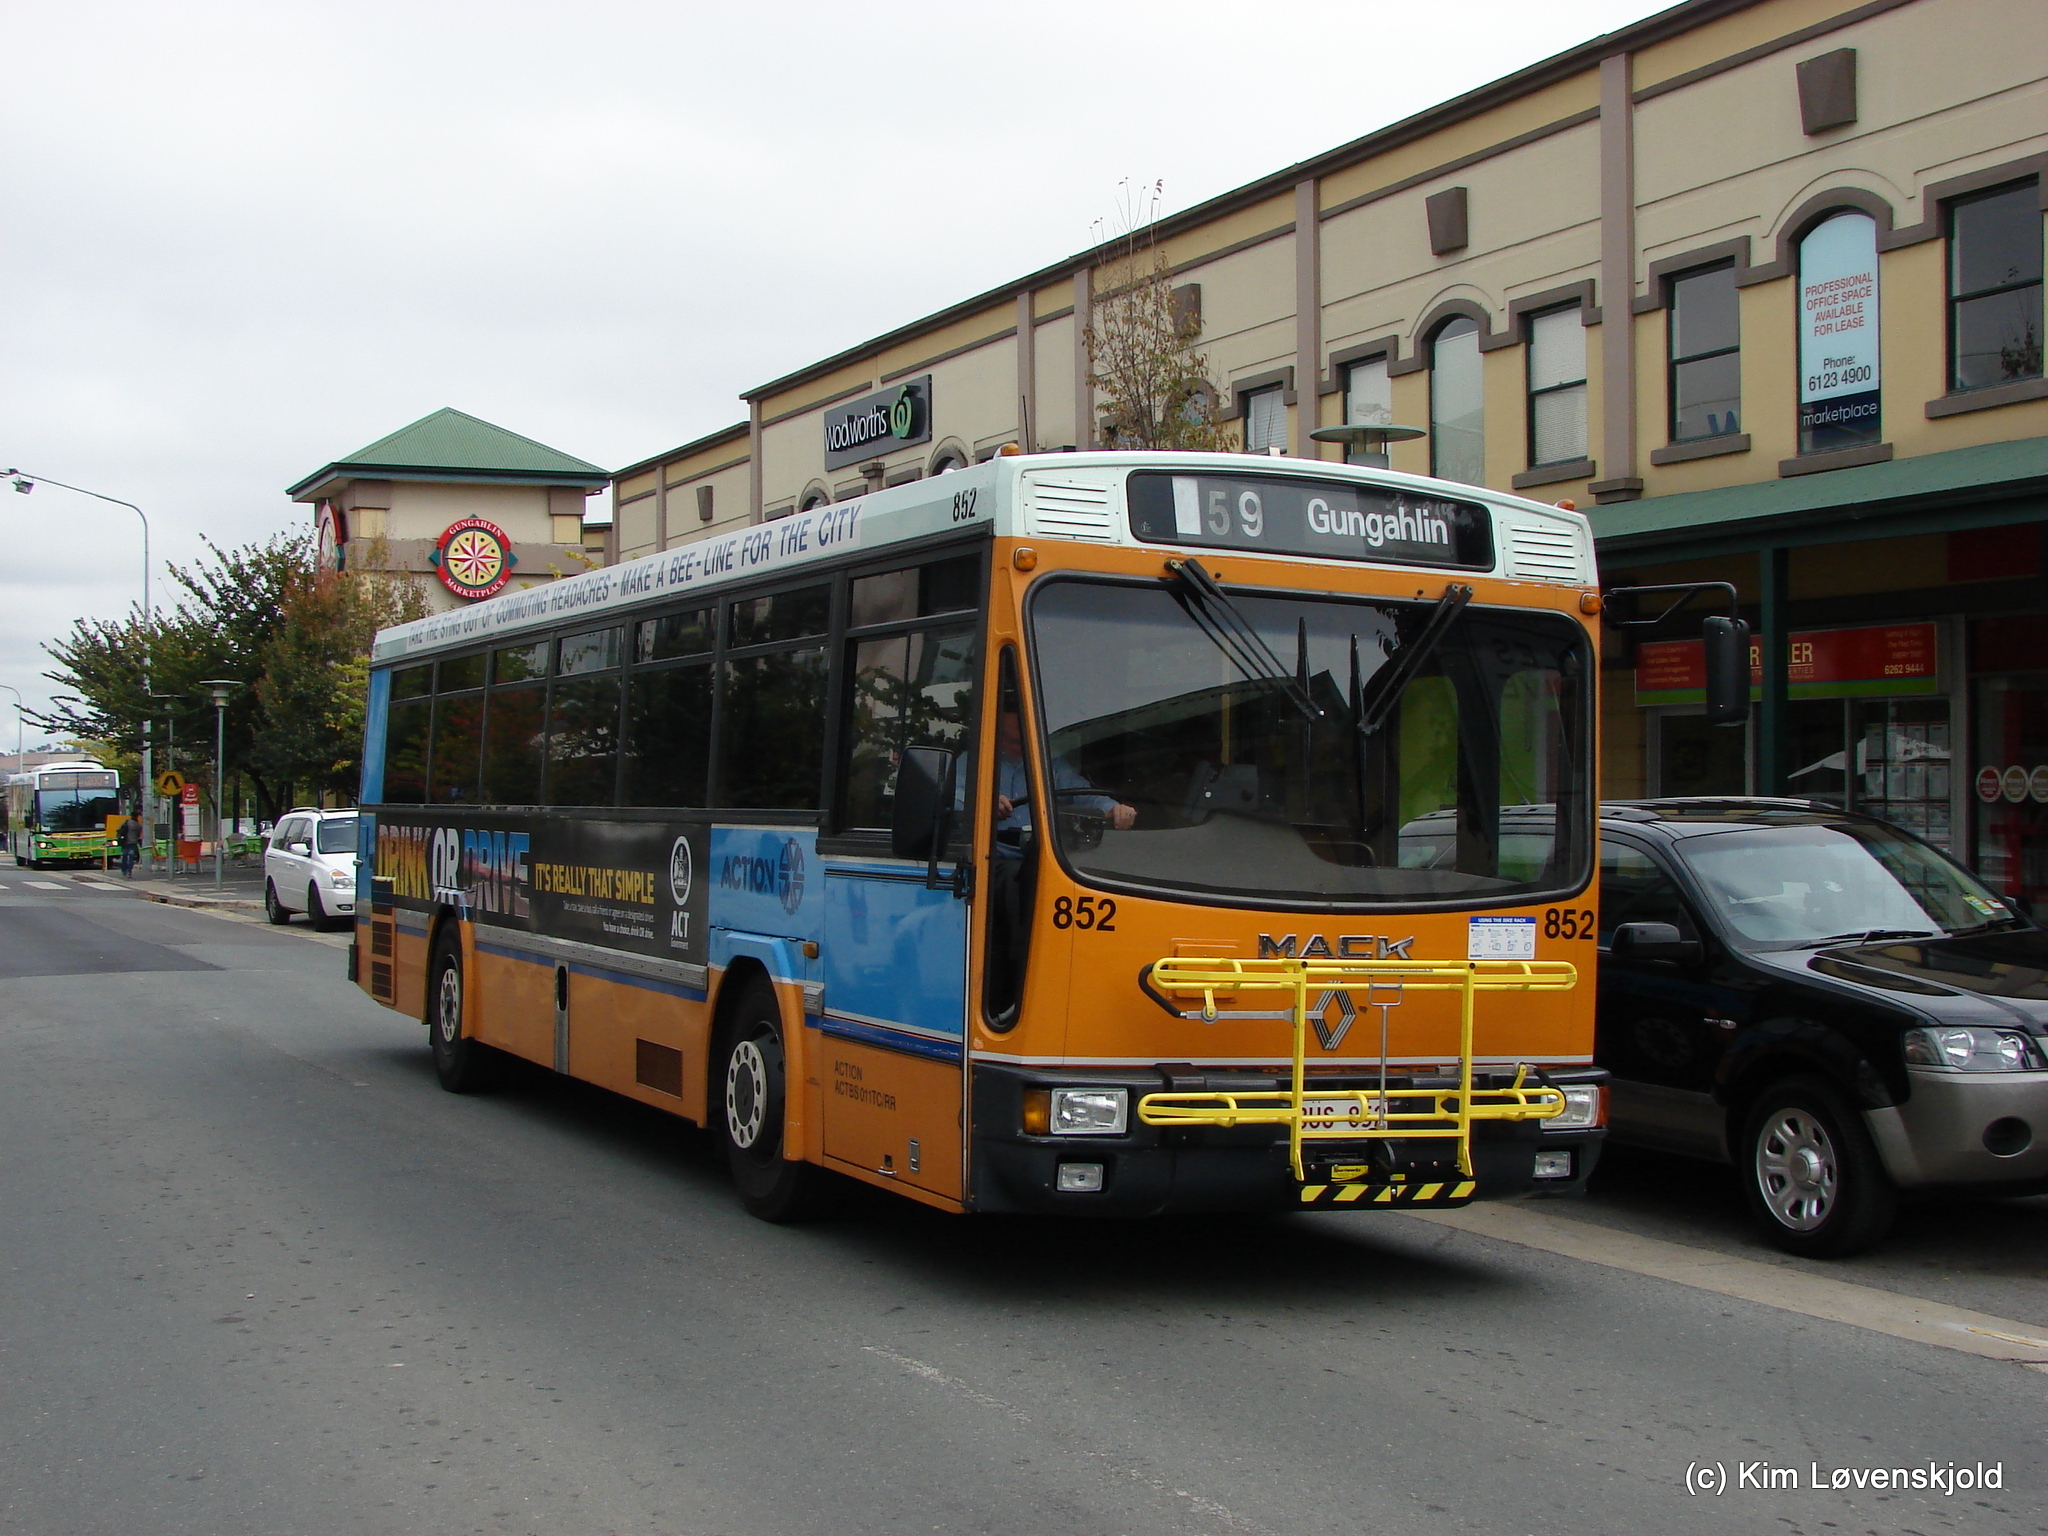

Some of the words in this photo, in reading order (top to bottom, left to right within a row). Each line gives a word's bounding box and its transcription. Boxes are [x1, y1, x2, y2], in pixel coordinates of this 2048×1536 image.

[1805, 272, 1873, 297] PROFESSIONAL
[1806, 294, 1839, 310] OFFICE
[1841, 286, 1872, 303] SPACE
[1814, 302, 1863, 323] AVAILABLE
[1814, 323, 1833, 337] FOR
[1835, 316, 1864, 332] LEASE
[1823, 355, 1855, 370] Phone:
[1808, 372, 1838, 391] 6123
[1841, 365, 1871, 385] 4900
[1803, 402, 1877, 426] marketplace
[952, 487, 976, 522] 852
[448, 520, 503, 538] GUNGAHLIN
[1307, 498, 1449, 548] Gungahlin
[441, 613, 463, 638] STING
[463, 608, 481, 633] OUT
[482, 603, 495, 628] OF
[496, 589, 549, 624] COMMUTING
[550, 573, 609, 612] HEADACHES
[620, 559, 652, 597] MAKE
[655, 559, 664, 588] A
[741, 530, 772, 567] FOR
[779, 519, 812, 557] THE
[817, 504, 862, 547] CITY
[445, 577, 506, 598] MARKETPLACE
[1884, 664, 1903, 675] 6262
[378, 824, 432, 900] DRINK
[432, 827, 460, 905] OR
[458, 829, 530, 918] DRIVE
[535, 863, 550, 892] IT'S
[552, 864, 587, 896] REALLY
[588, 867, 613, 899] THAT
[615, 870, 655, 904] SIMPLE
[720, 855, 775, 893] ACTION
[671, 910, 690, 938] ACT
[1053, 896, 1117, 932] 852
[1544, 908, 1594, 939] 852
[1257, 933, 1414, 960] MACK
[834, 1060, 863, 1082] ACTION
